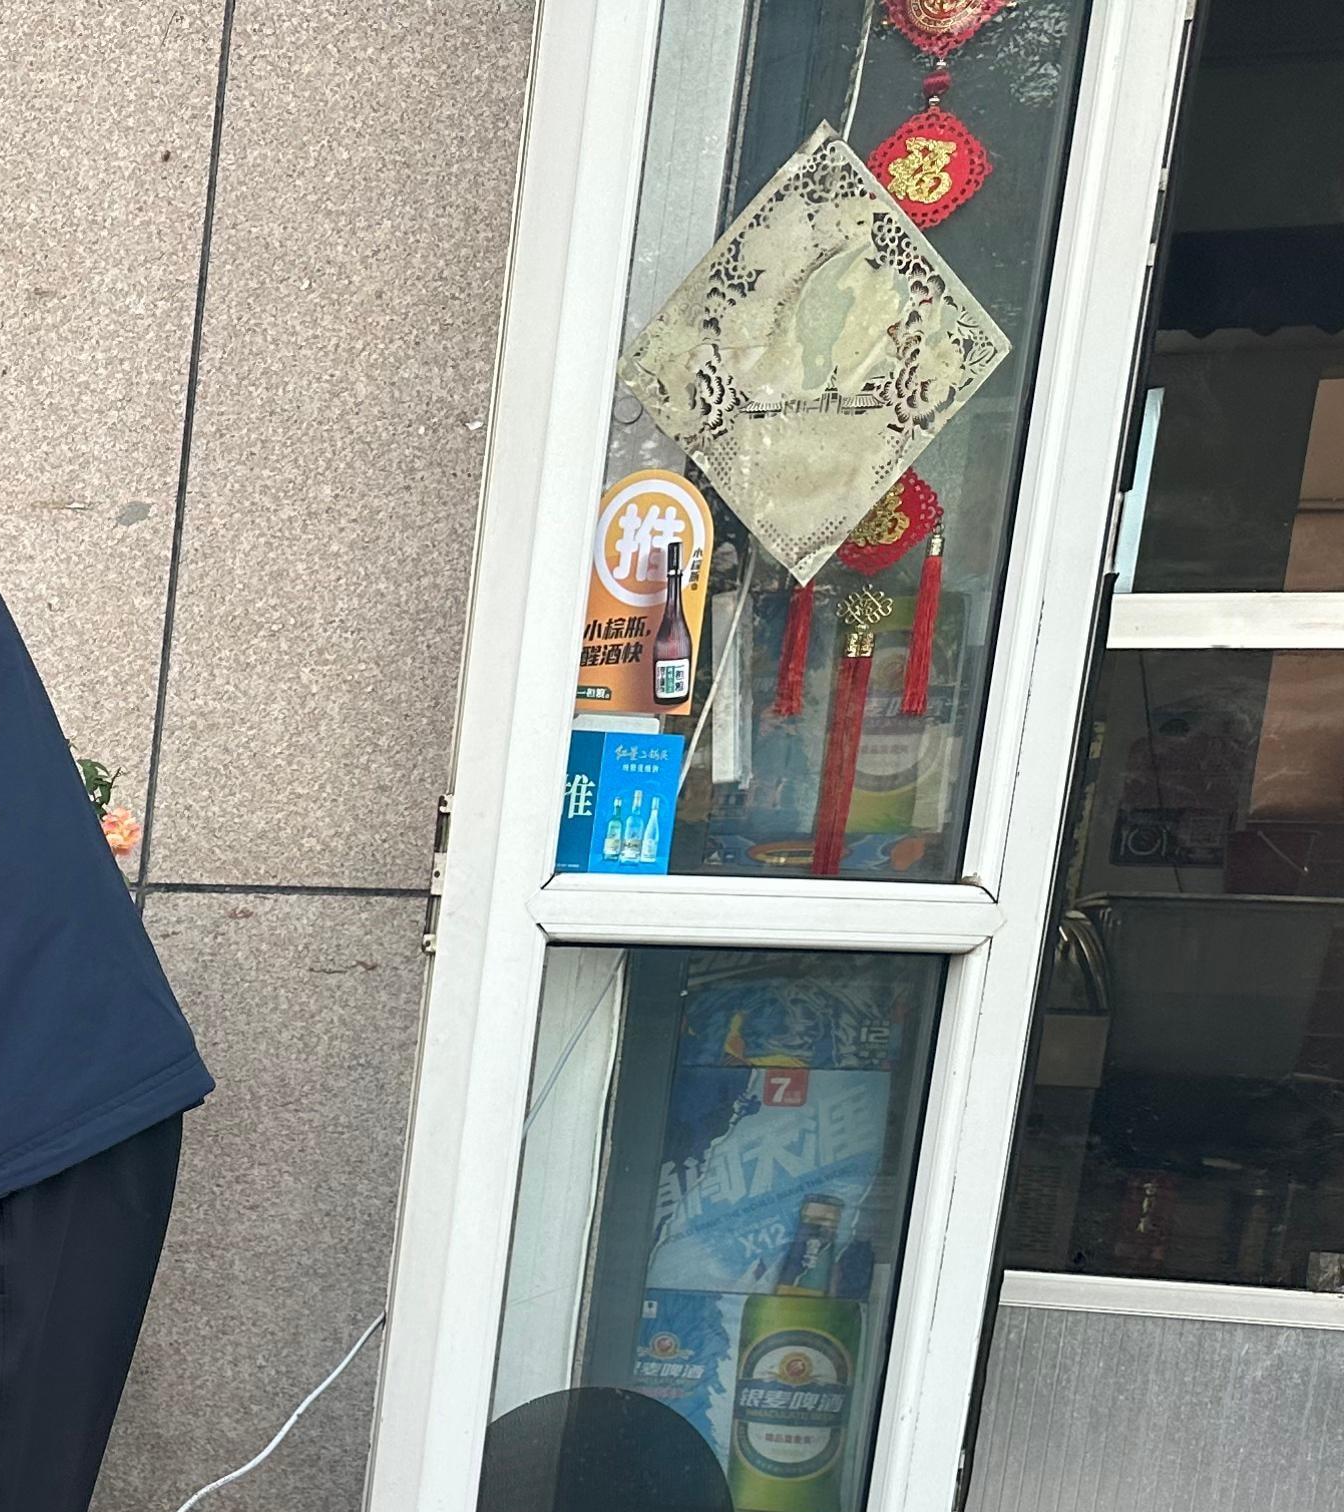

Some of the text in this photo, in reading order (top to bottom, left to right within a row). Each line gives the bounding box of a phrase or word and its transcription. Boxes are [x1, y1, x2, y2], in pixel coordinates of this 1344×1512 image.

[888, 137, 957, 204] 福
[613, 504, 685, 581] 推
[579, 642, 643, 667] 醒酒快
[770, 1077, 792, 1104] 7
[739, 1386, 846, 1413] 银麦啤酒
